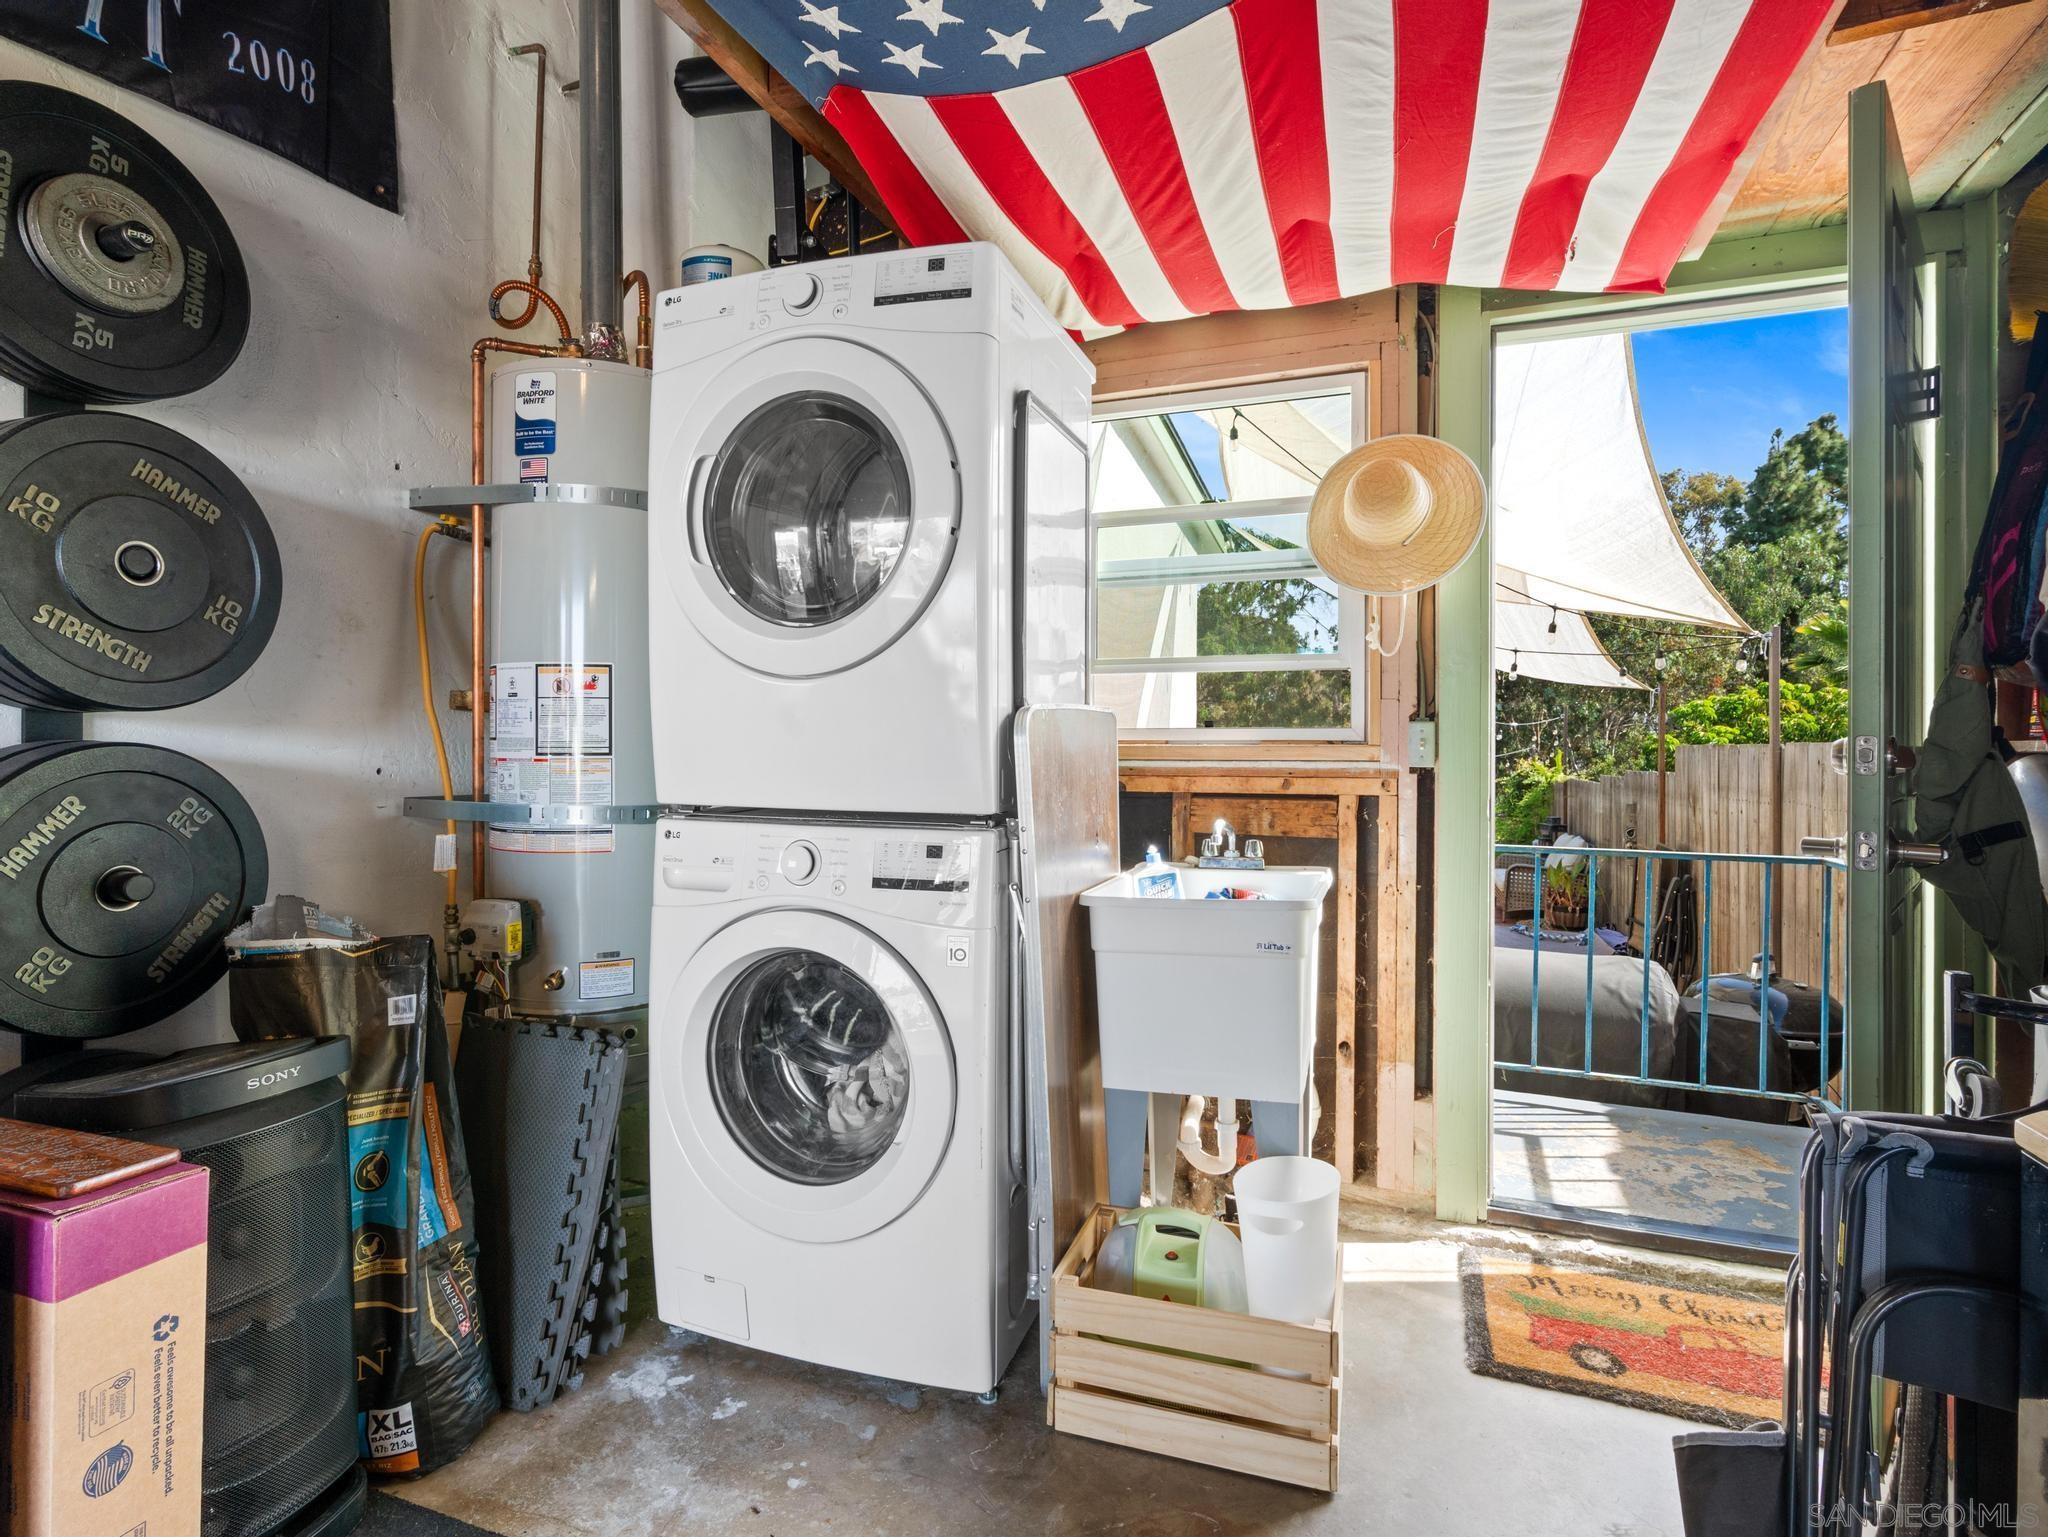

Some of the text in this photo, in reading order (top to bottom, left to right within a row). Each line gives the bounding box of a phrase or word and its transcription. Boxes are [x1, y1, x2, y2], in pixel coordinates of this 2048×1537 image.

[222, 31, 316, 104] 2008
[89, 135, 110, 174] KG
[183, 244, 208, 330] HAMMER
[72, 312, 95, 351] KG
[94, 329, 114, 349] 5
[517, 389, 555, 399] BRADFORD
[523, 397, 546, 405] WHITE
[23, 484, 61, 513] 10
[130, 459, 221, 526] HAMMER
[7, 496, 55, 533] KG
[203, 606, 239, 636] KG
[215, 595, 243, 618] 10
[32, 604, 153, 673] STRENGTH
[167, 797, 200, 829] 20
[179, 806, 215, 839] KG
[0, 795, 87, 880] HAMMER
[147, 892, 230, 983] STRENGTH
[14, 947, 54, 983] 20
[30, 956, 73, 994] KG
[246, 1065, 302, 1090] SONY
[441, 1278, 464, 1321] PURINA
[449, 1241, 484, 1347] PRO PLAN
[151, 1348, 163, 1474] Feels even better to recycle.
[163, 1341, 176, 1497] Feels awesome to be all unpacked.
[370, 1410, 412, 1436] XL
